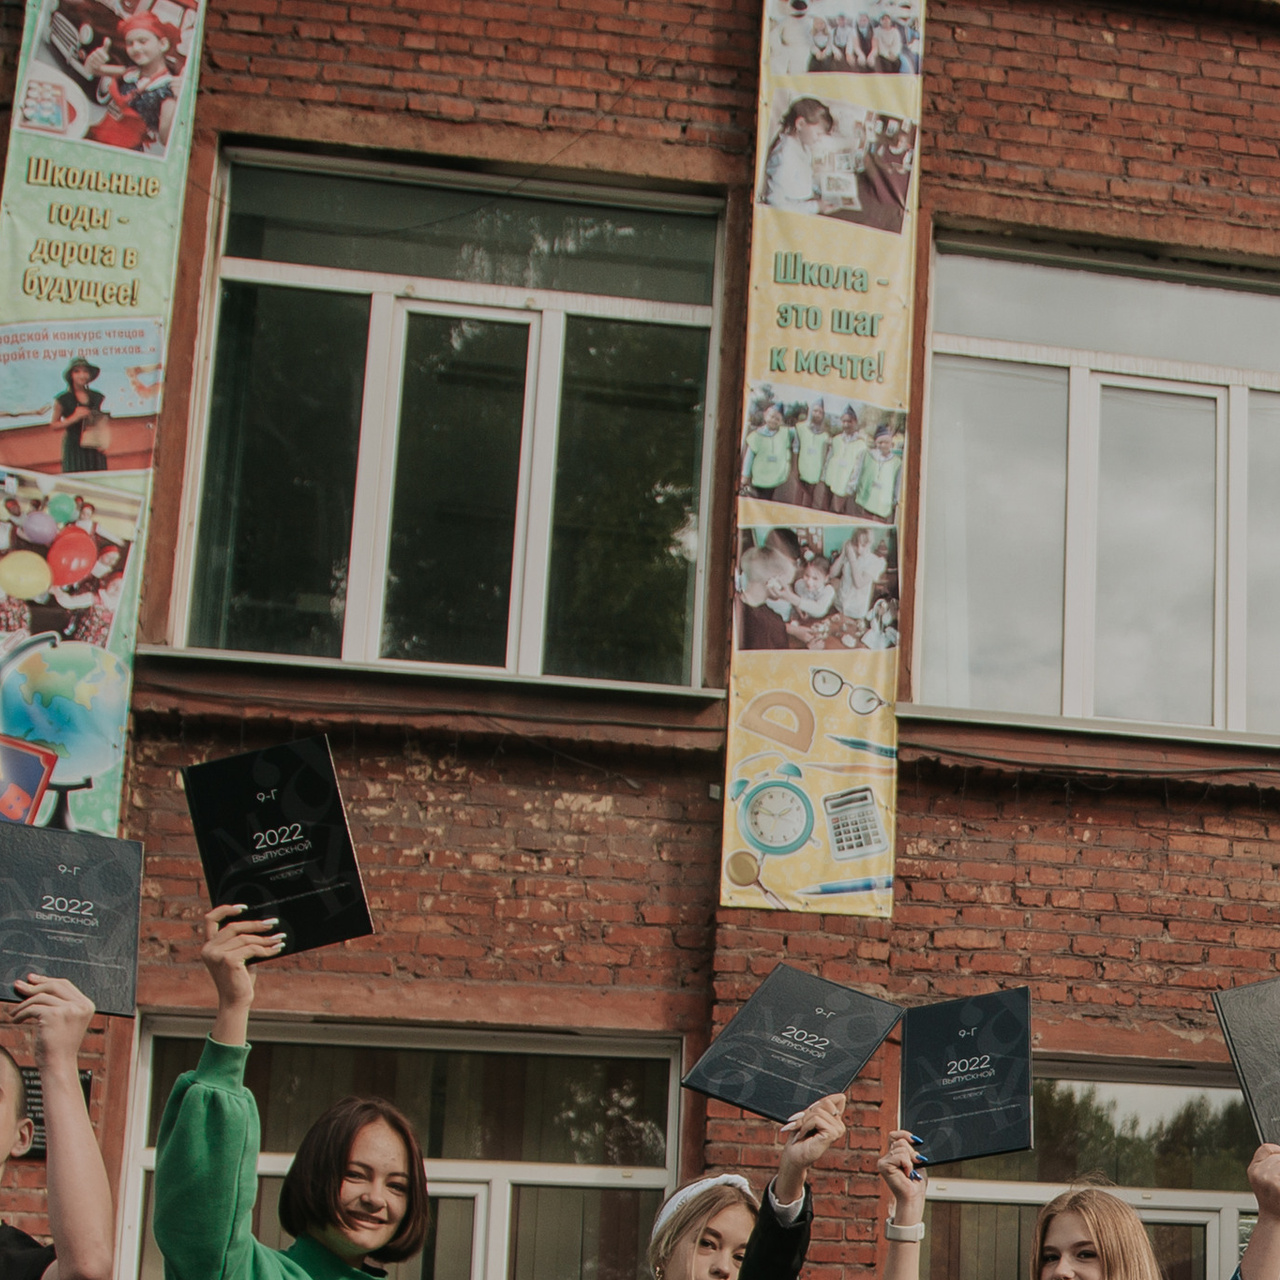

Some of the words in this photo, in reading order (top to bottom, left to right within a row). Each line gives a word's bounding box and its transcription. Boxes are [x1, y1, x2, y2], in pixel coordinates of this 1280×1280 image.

[26, 156, 160, 198] Школьные
[49, 200, 111, 229] годы
[30, 238, 115, 268] дорога
[124, 246, 138, 268] в
[774, 251, 868, 292] Школа
[23, 267, 139, 307] будущее!
[776, 303, 822, 330] это
[831, 308, 884, 337] шаг
[0, 328, 49, 345] одской
[53, 328, 102, 342] конкурс
[0, 347, 39, 365] ройте
[770, 347, 786, 373] к
[795, 349, 885, 384] мечте!
[252, 823, 304, 850] 2022
[35, 911, 99, 927] ВЫПУСКНОЙ
[41, 895, 94, 916] 2022
[781, 1025, 830, 1051] 2022
[947, 1054, 991, 1075] 2022
